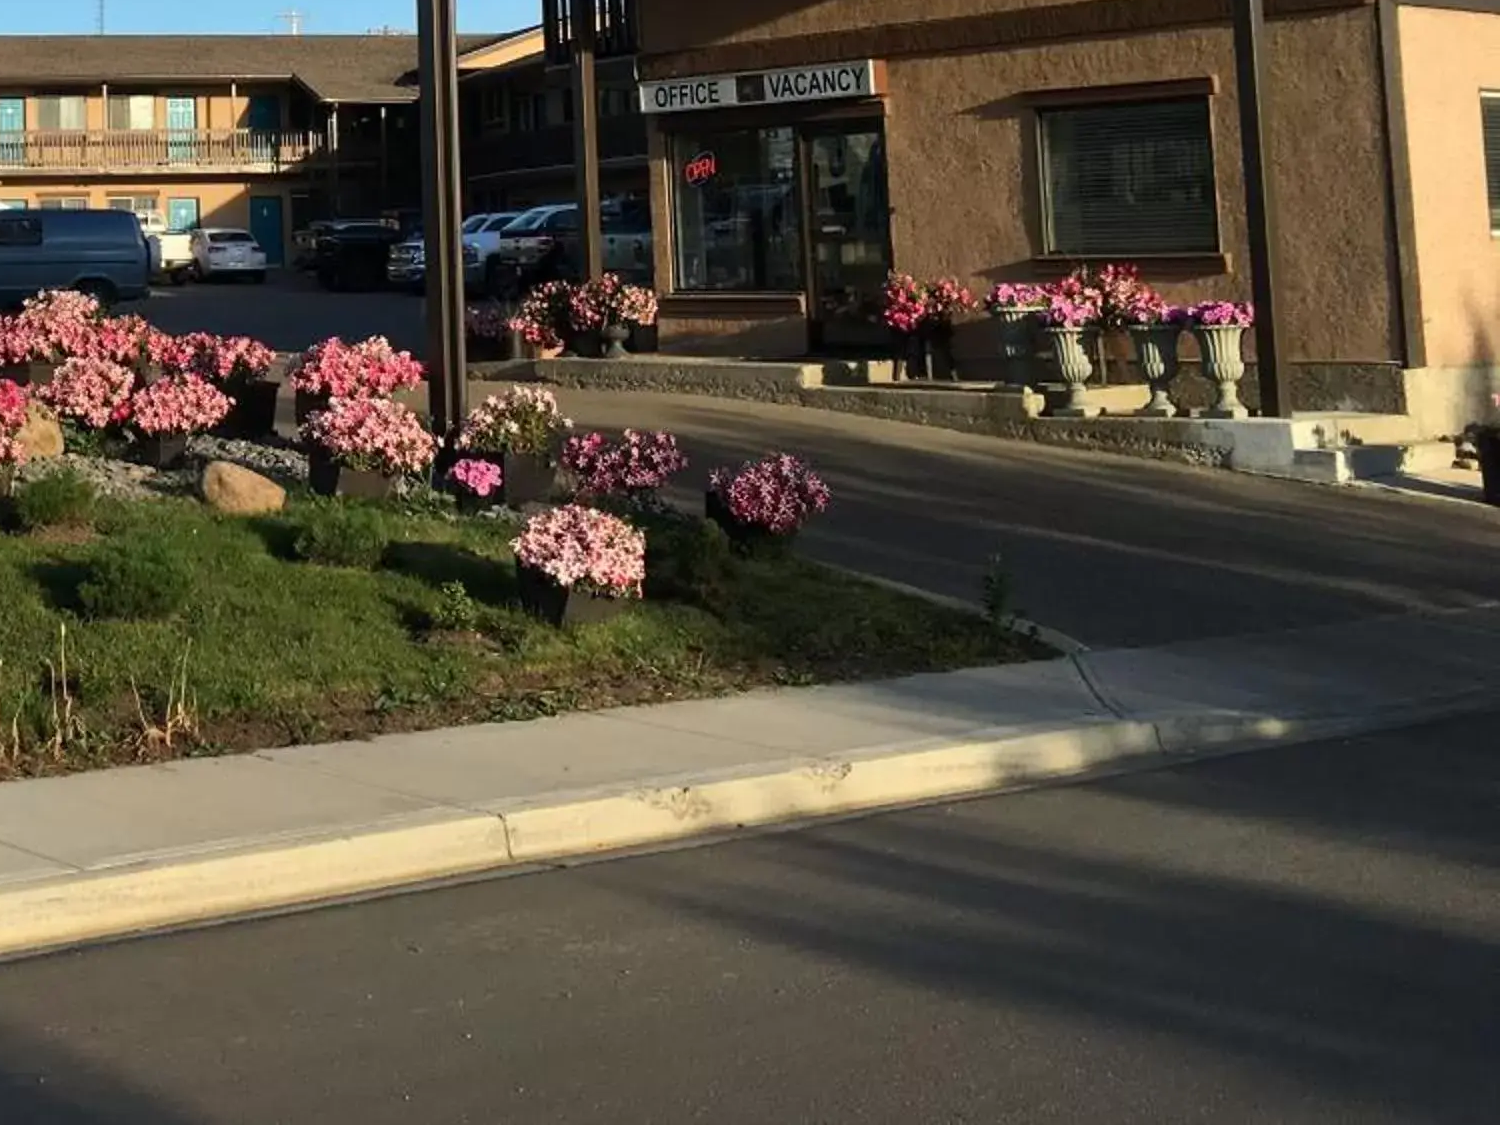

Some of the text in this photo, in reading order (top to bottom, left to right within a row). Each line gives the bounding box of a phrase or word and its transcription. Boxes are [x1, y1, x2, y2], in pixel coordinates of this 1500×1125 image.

[654, 66, 865, 108] OFFICE VACANCY
[685, 158, 716, 182] OPEN
